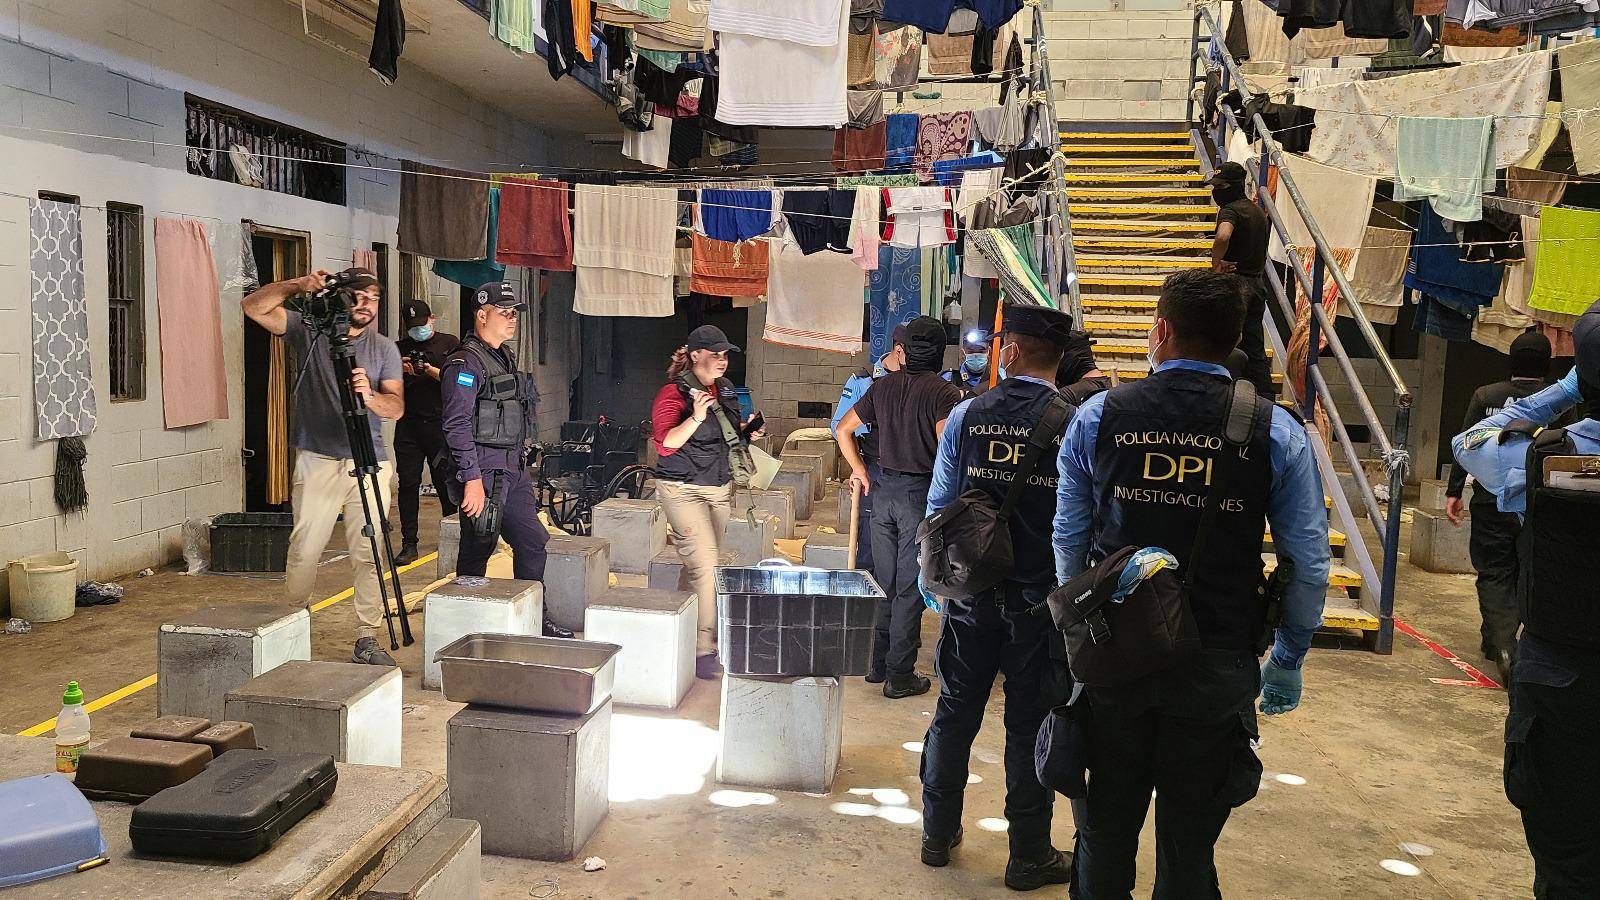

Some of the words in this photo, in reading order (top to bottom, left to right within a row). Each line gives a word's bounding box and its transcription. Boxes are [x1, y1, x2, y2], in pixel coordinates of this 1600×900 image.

[969, 424, 1009, 437] POLICIA
[1114, 431, 1170, 447] POLICIA
[1142, 452, 1213, 486] DPI
[1074, 589, 1092, 604] Canon
